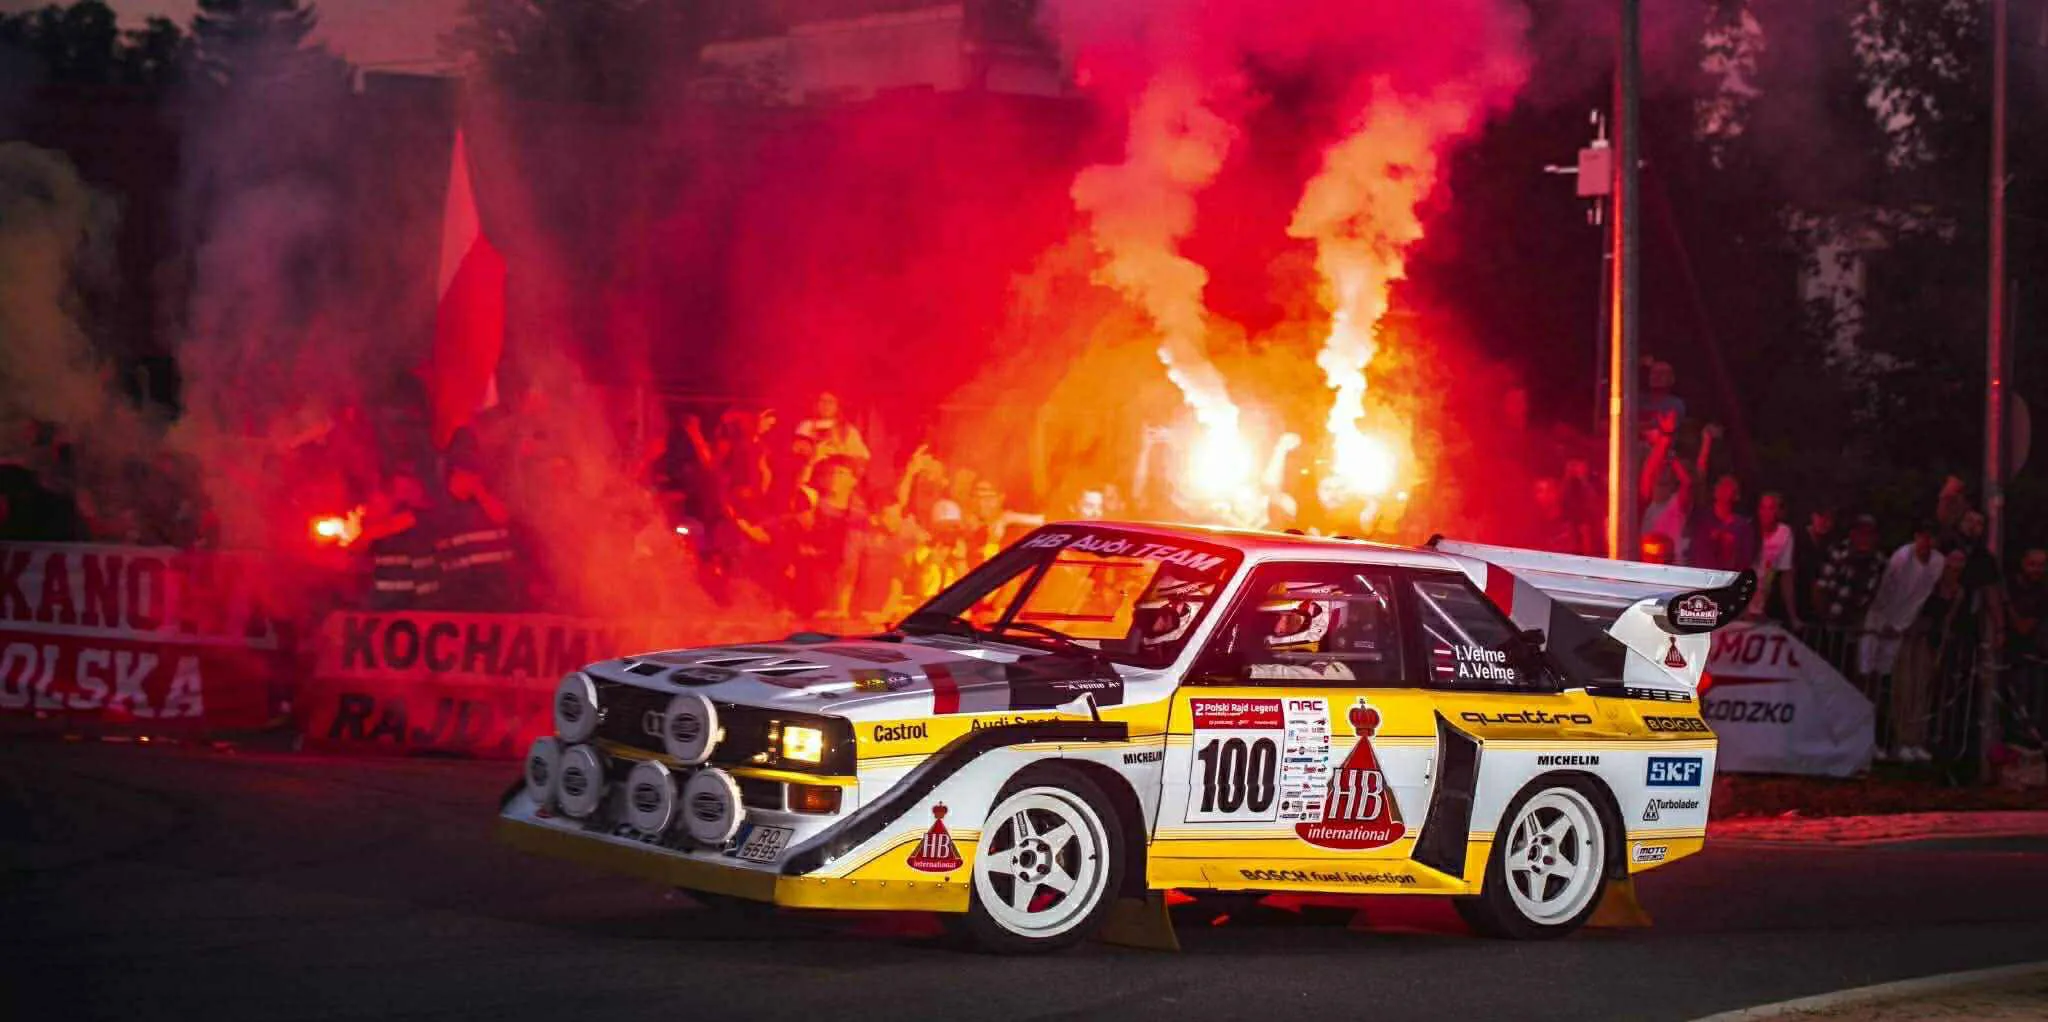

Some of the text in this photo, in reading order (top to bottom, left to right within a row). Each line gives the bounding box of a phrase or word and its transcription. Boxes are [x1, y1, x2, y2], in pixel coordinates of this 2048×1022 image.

[1020, 533, 1226, 572] HB Audi TEAM
[1456, 644, 1506, 662] I.Velme
[1459, 661, 1515, 680] A.Velme
[1195, 703, 1204, 717] 2
[1204, 703, 1230, 713] Polski
[1231, 703, 1249, 714] Rajd
[1250, 703, 1279, 714] Legend
[1460, 710, 1593, 726] quattro
[873, 722, 929, 742] Castrol
[1646, 719, 1705, 731] BOGE
[1122, 750, 1163, 765] MICHELIN
[1537, 755, 1600, 766] MICHELIN
[1197, 737, 1277, 814] 100
[1649, 761, 1701, 781] SKF
[1327, 768, 1384, 820] HB
[1656, 799, 1700, 809] Turbolader
[1307, 824, 1391, 841] international
[921, 833, 951, 859] HB
[913, 861, 957, 869] international
[1239, 869, 1417, 885] BOSCH fuel injection
